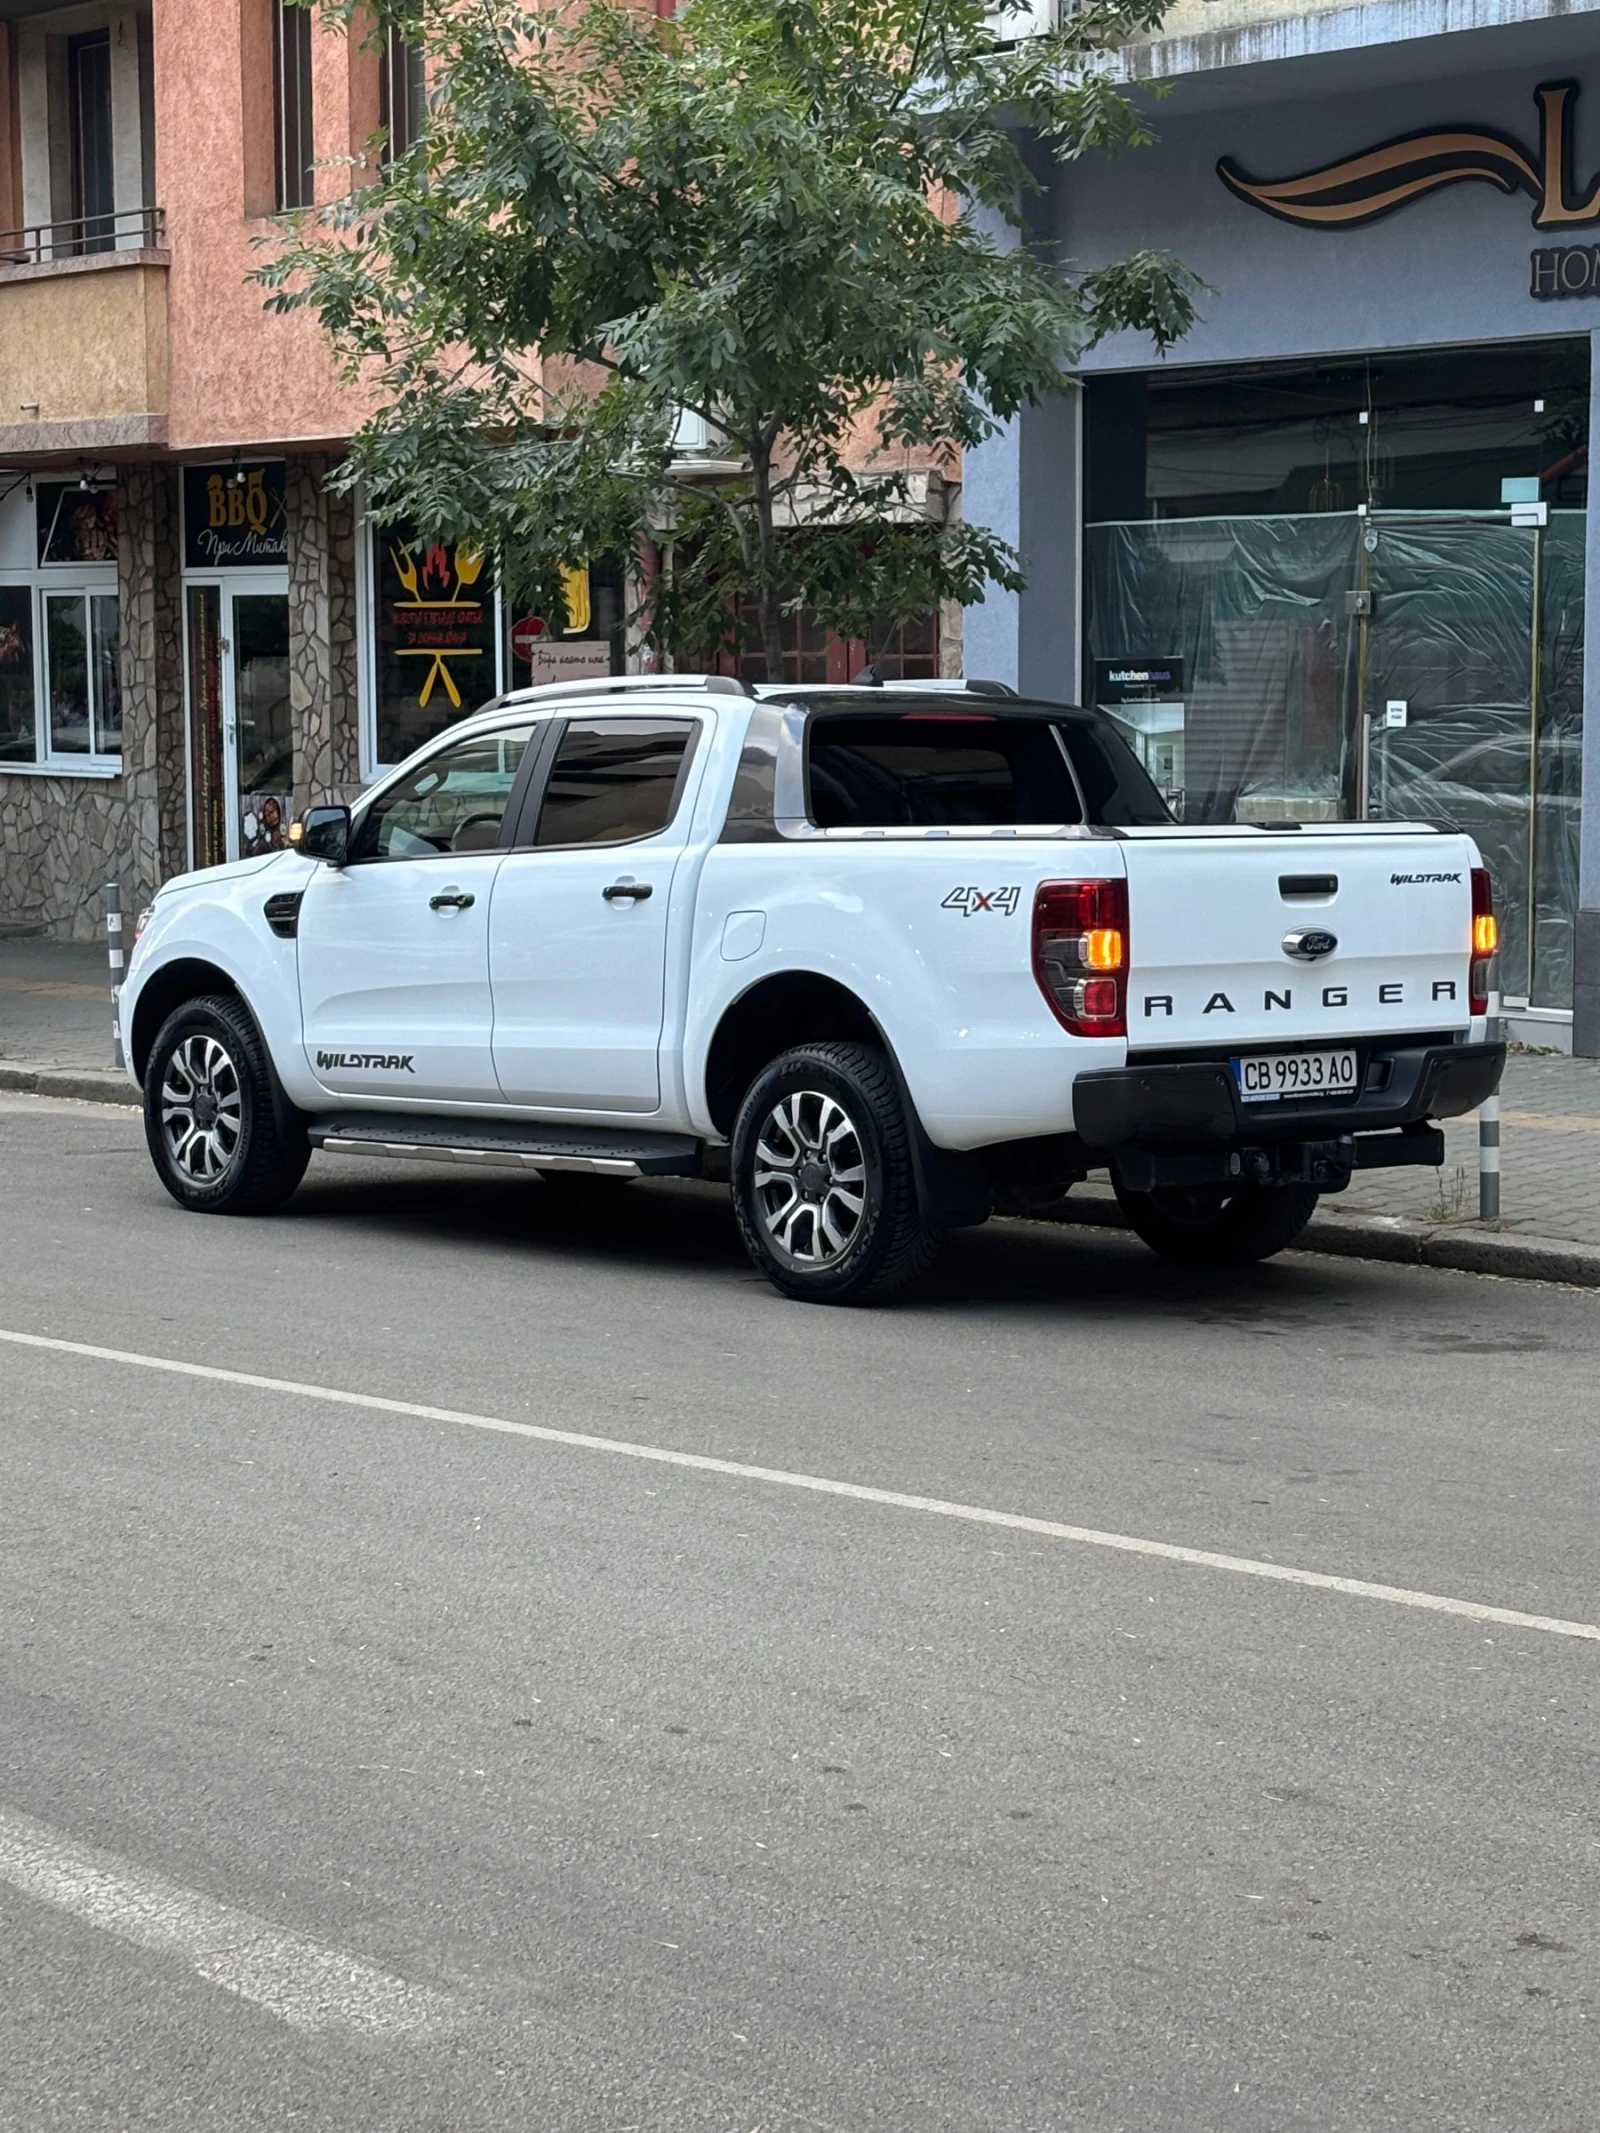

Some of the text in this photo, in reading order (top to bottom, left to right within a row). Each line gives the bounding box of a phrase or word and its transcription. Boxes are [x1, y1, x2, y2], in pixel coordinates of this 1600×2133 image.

[207, 469, 267, 535] BBQ
[1390, 873, 1462, 886] WILDTRAK
[1306, 934, 1331, 951] Ford
[1144, 981, 1456, 1017] RANGER
[316, 1050, 416, 1074] WILDTRAK
[1244, 1061, 1271, 1090] CB
[1275, 1057, 1324, 1089] 9933
